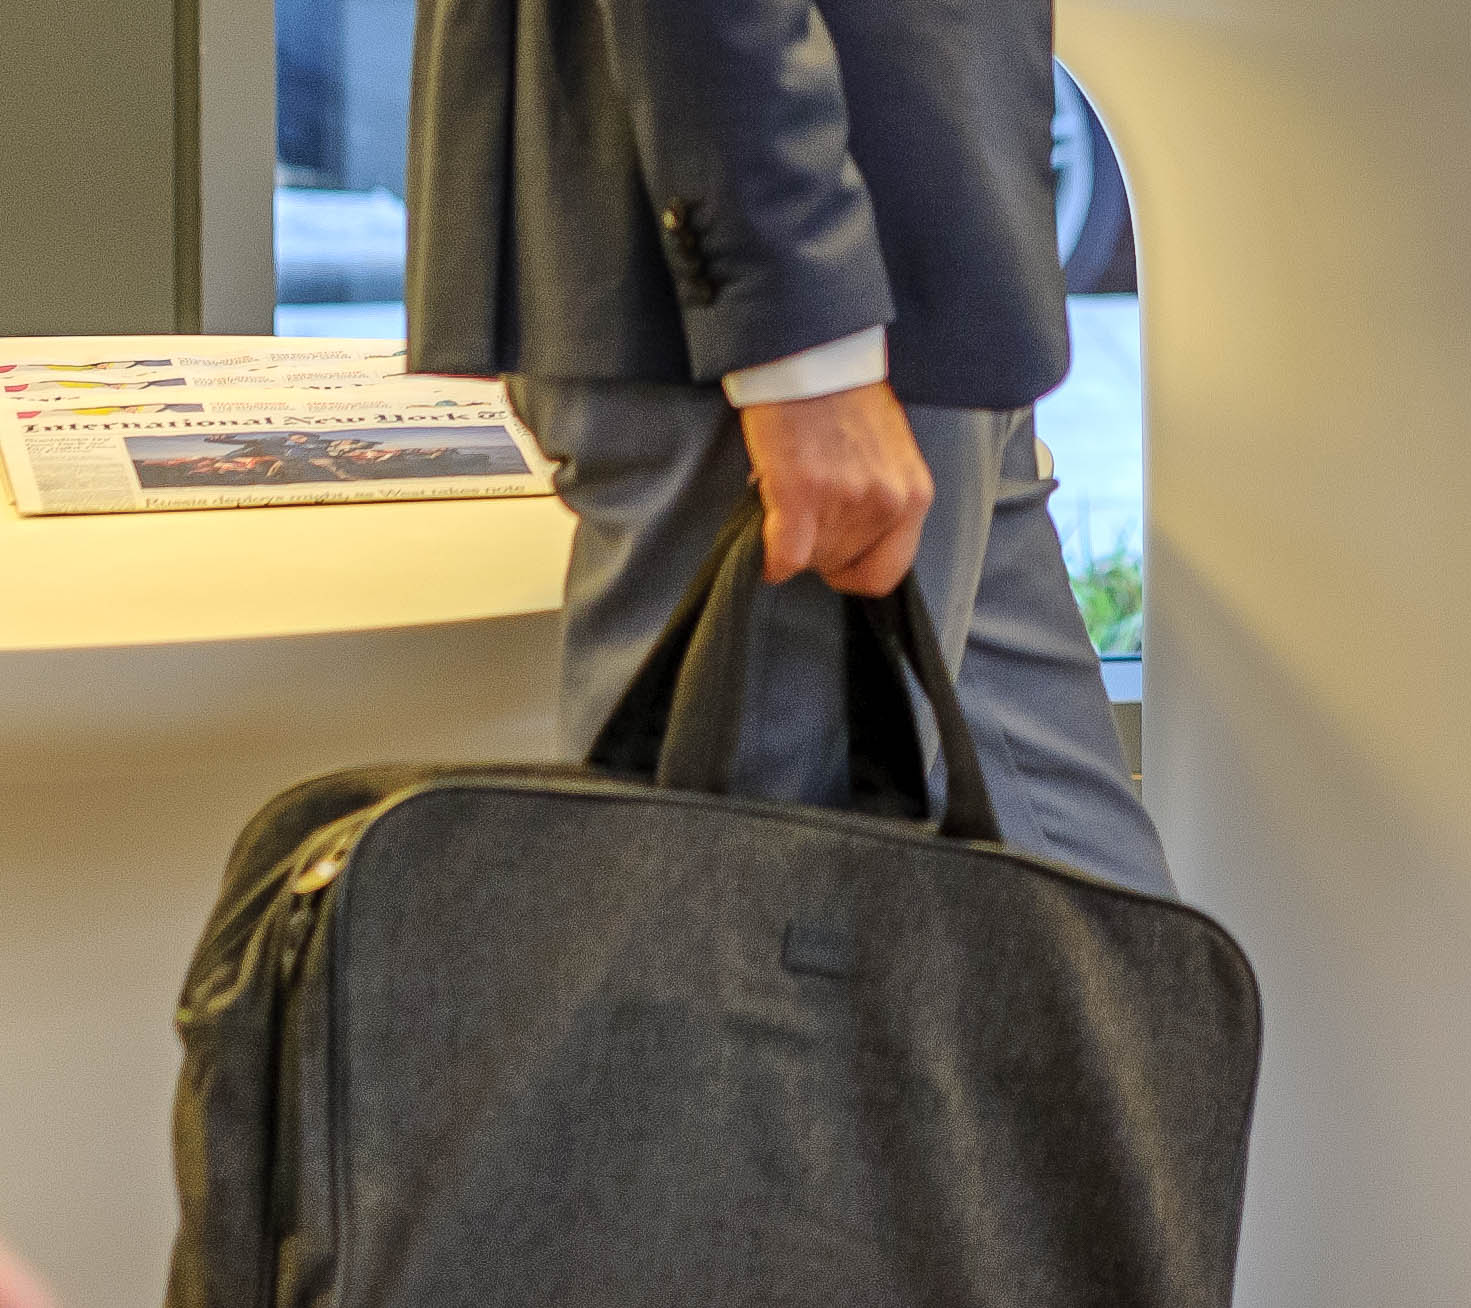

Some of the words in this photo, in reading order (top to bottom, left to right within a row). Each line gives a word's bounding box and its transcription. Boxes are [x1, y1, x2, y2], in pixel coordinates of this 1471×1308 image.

[24, 416, 273, 434] International
[283, 415, 366, 426] New
[374, 412, 471, 425] York
